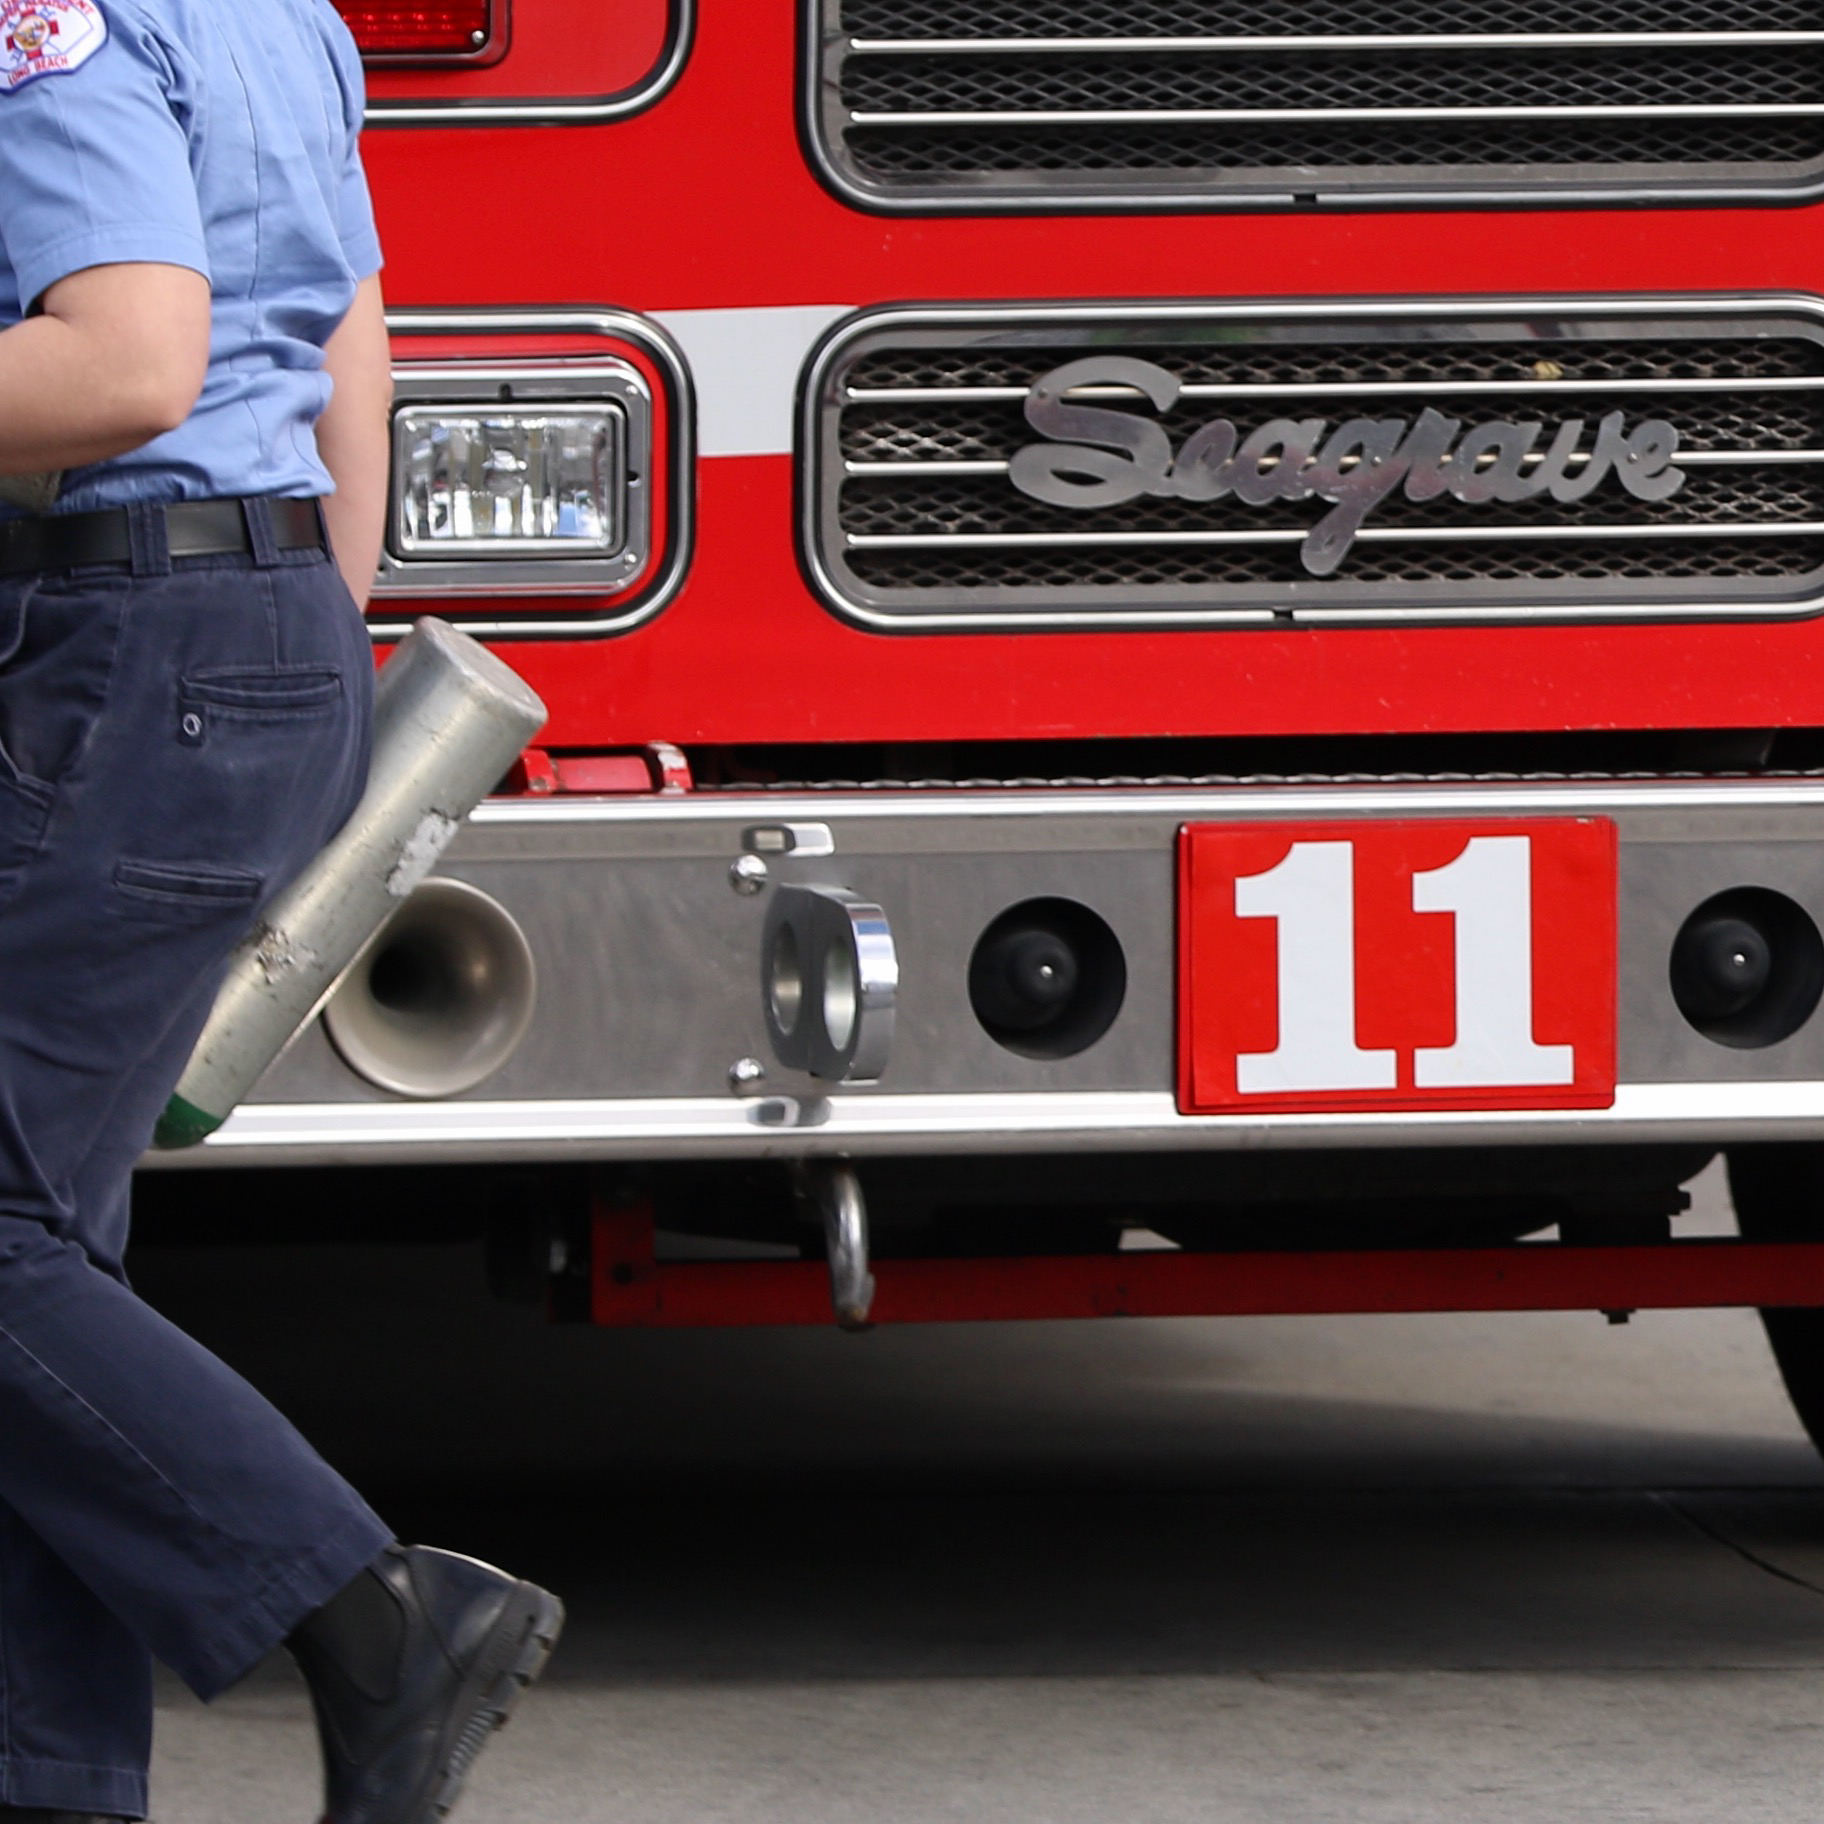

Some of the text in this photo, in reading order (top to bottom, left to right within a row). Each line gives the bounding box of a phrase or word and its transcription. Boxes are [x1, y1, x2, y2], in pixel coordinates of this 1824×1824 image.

[9, 55, 68, 86] LONG BEACH
[1010, 355, 1685, 575] Seagrave
[1235, 836, 1573, 1094] 11
